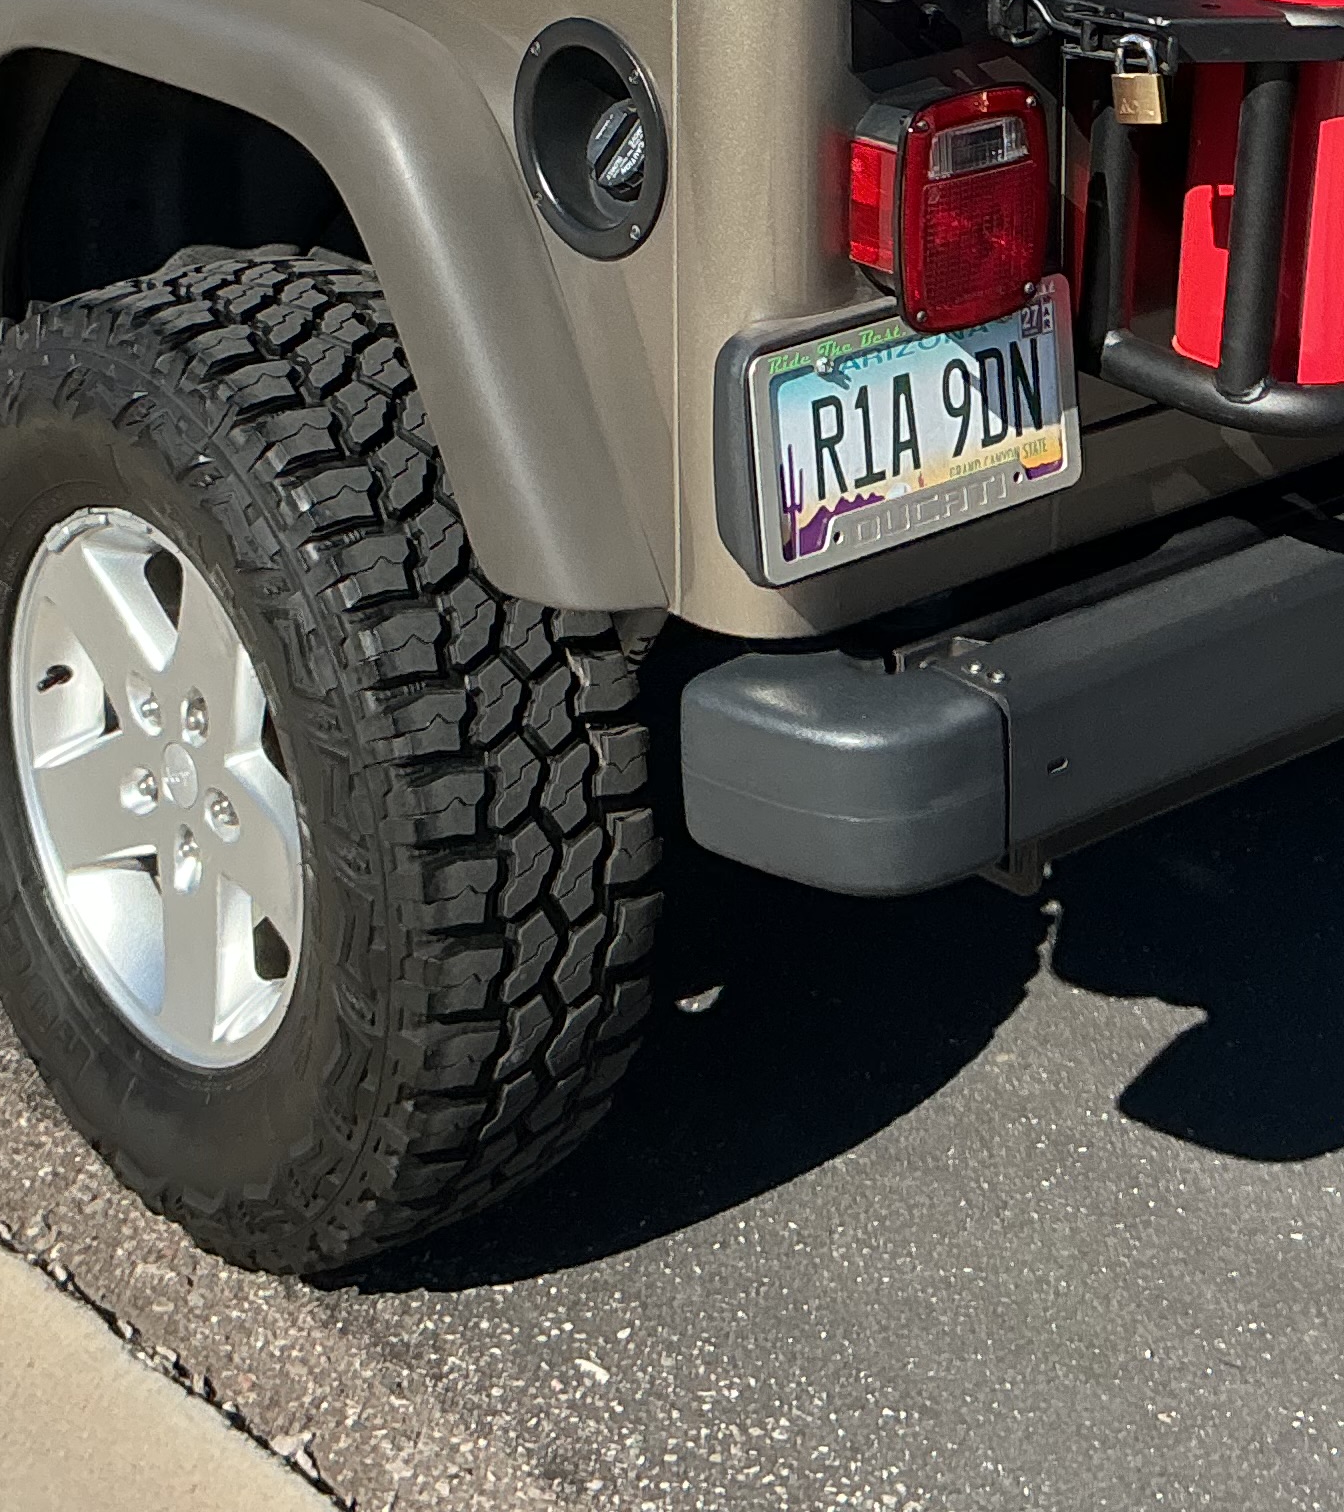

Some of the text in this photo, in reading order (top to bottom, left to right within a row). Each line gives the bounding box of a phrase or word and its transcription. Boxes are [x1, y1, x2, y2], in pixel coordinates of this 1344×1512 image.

[1021, 305, 1039, 330] 27
[767, 351, 812, 376] Ride
[816, 339, 853, 358] The
[811, 337, 1044, 502] R1A 9DN
[1022, 437, 1048, 460] STATE
[856, 472, 1007, 543] DUCATI
